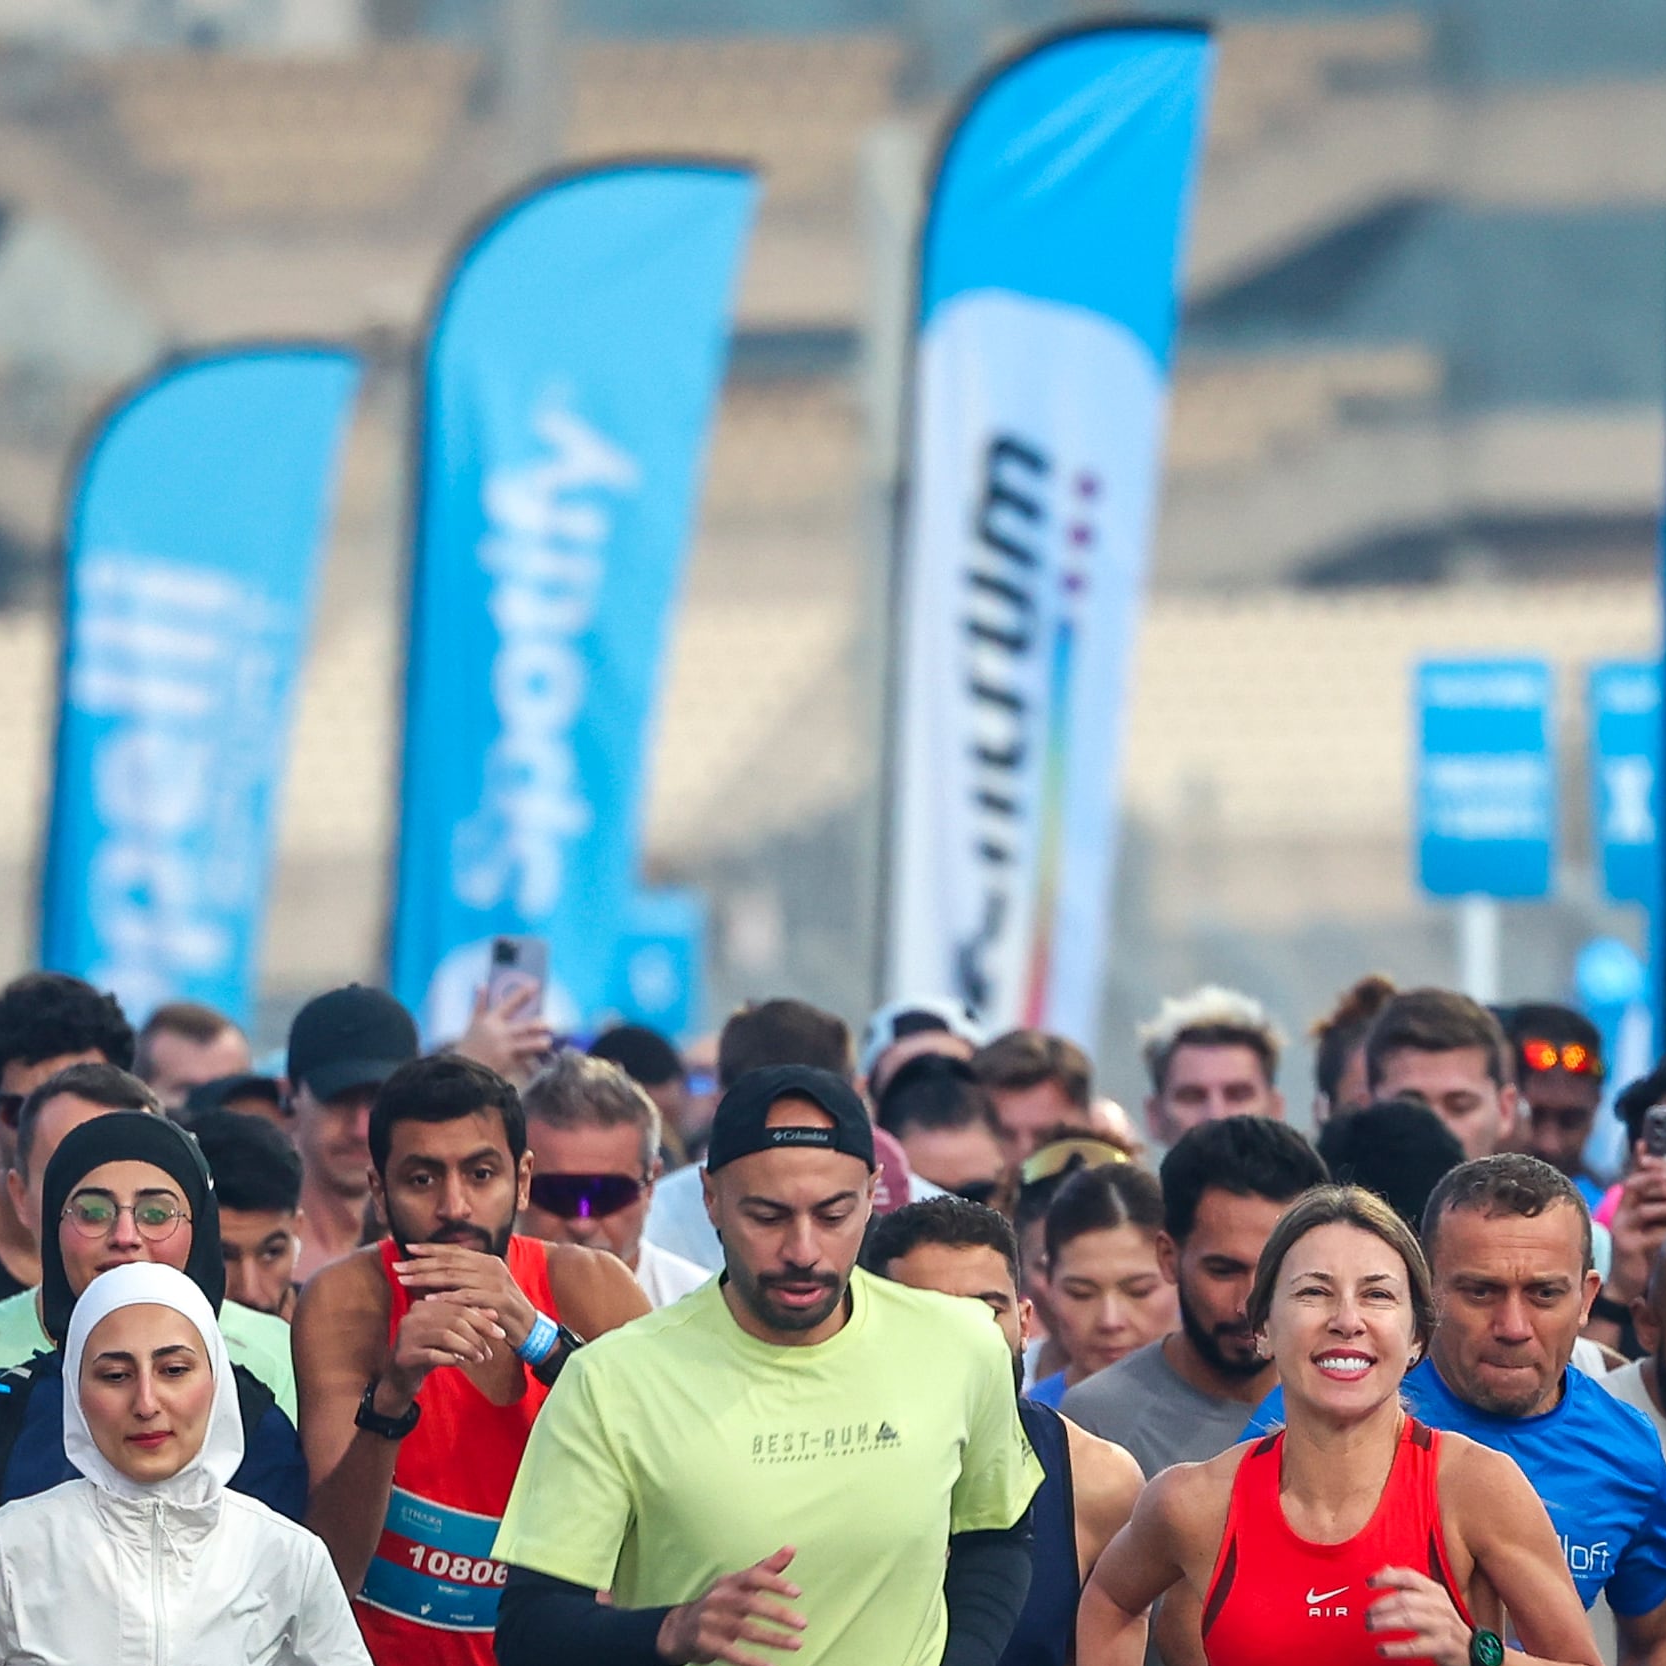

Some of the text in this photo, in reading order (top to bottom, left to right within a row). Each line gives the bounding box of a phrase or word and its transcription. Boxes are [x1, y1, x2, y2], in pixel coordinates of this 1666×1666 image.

[409, 1545, 508, 1584] 10806
[1556, 1534, 1611, 1572] loft
[1308, 1607, 1348, 1617] AIR
